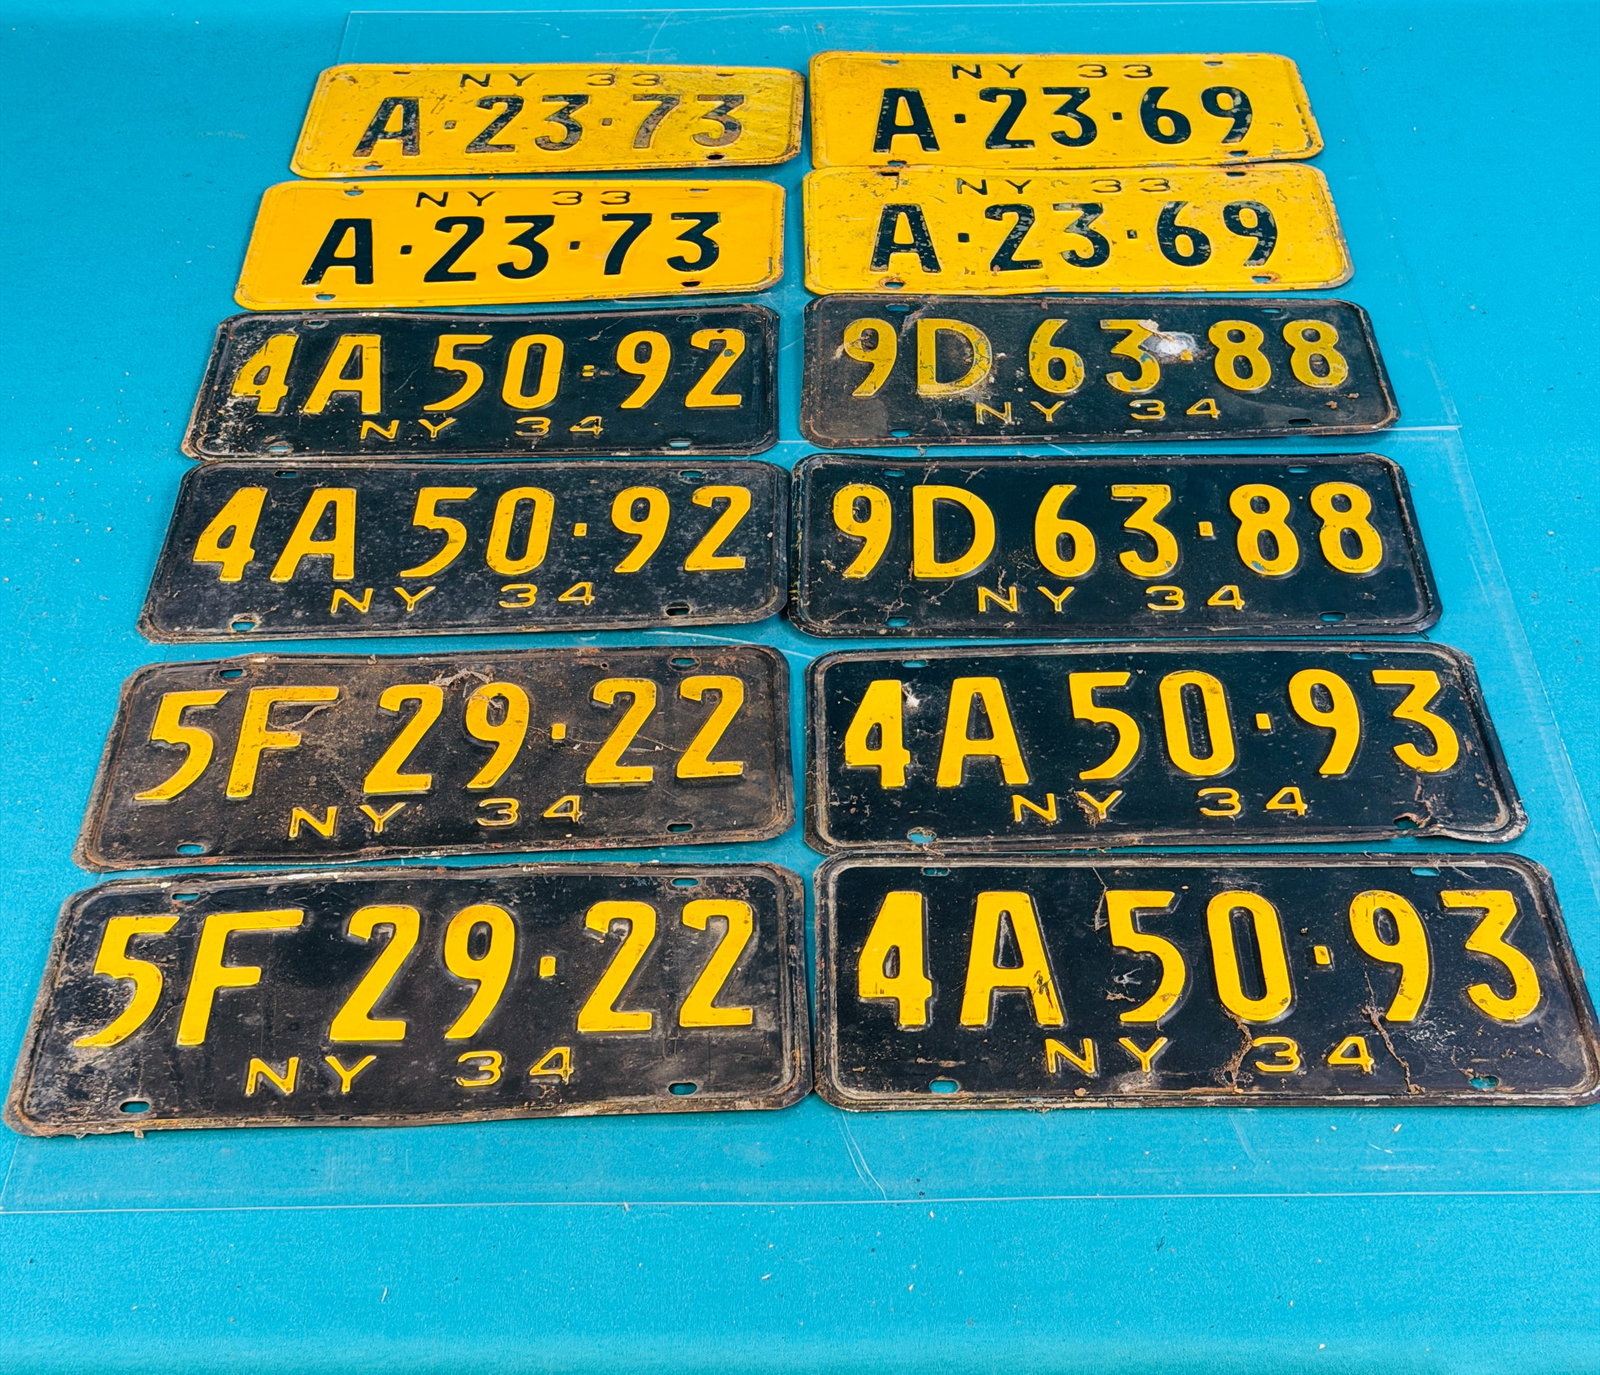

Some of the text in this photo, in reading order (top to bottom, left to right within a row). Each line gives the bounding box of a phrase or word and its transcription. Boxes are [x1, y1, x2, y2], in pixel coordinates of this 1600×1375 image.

[459, 73, 661, 88] NY 33
[951, 64, 1153, 80] NY 33
[416, 191, 630, 207] NY 33
[956, 178, 1172, 195] NY 33
[230, 333, 382, 415] 4A
[842, 318, 994, 398] 9D
[360, 415, 604, 441] NY 34
[976, 399, 1222, 424] NY 34
[192, 487, 357, 583] 4A
[832, 483, 996, 580] 9D
[330, 582, 596, 614] NY 34
[977, 585, 1246, 614] NY 34
[134, 685, 340, 803] 5F
[844, 676, 1031, 789] 4A
[288, 794, 582, 838] NY 34
[1011, 787, 1308, 825] NY 34
[72, 907, 305, 1048] 5F
[857, 890, 1064, 1028] 4A
[246, 1046, 574, 1096] NY 34
[1044, 1035, 1374, 1075] NY 34
